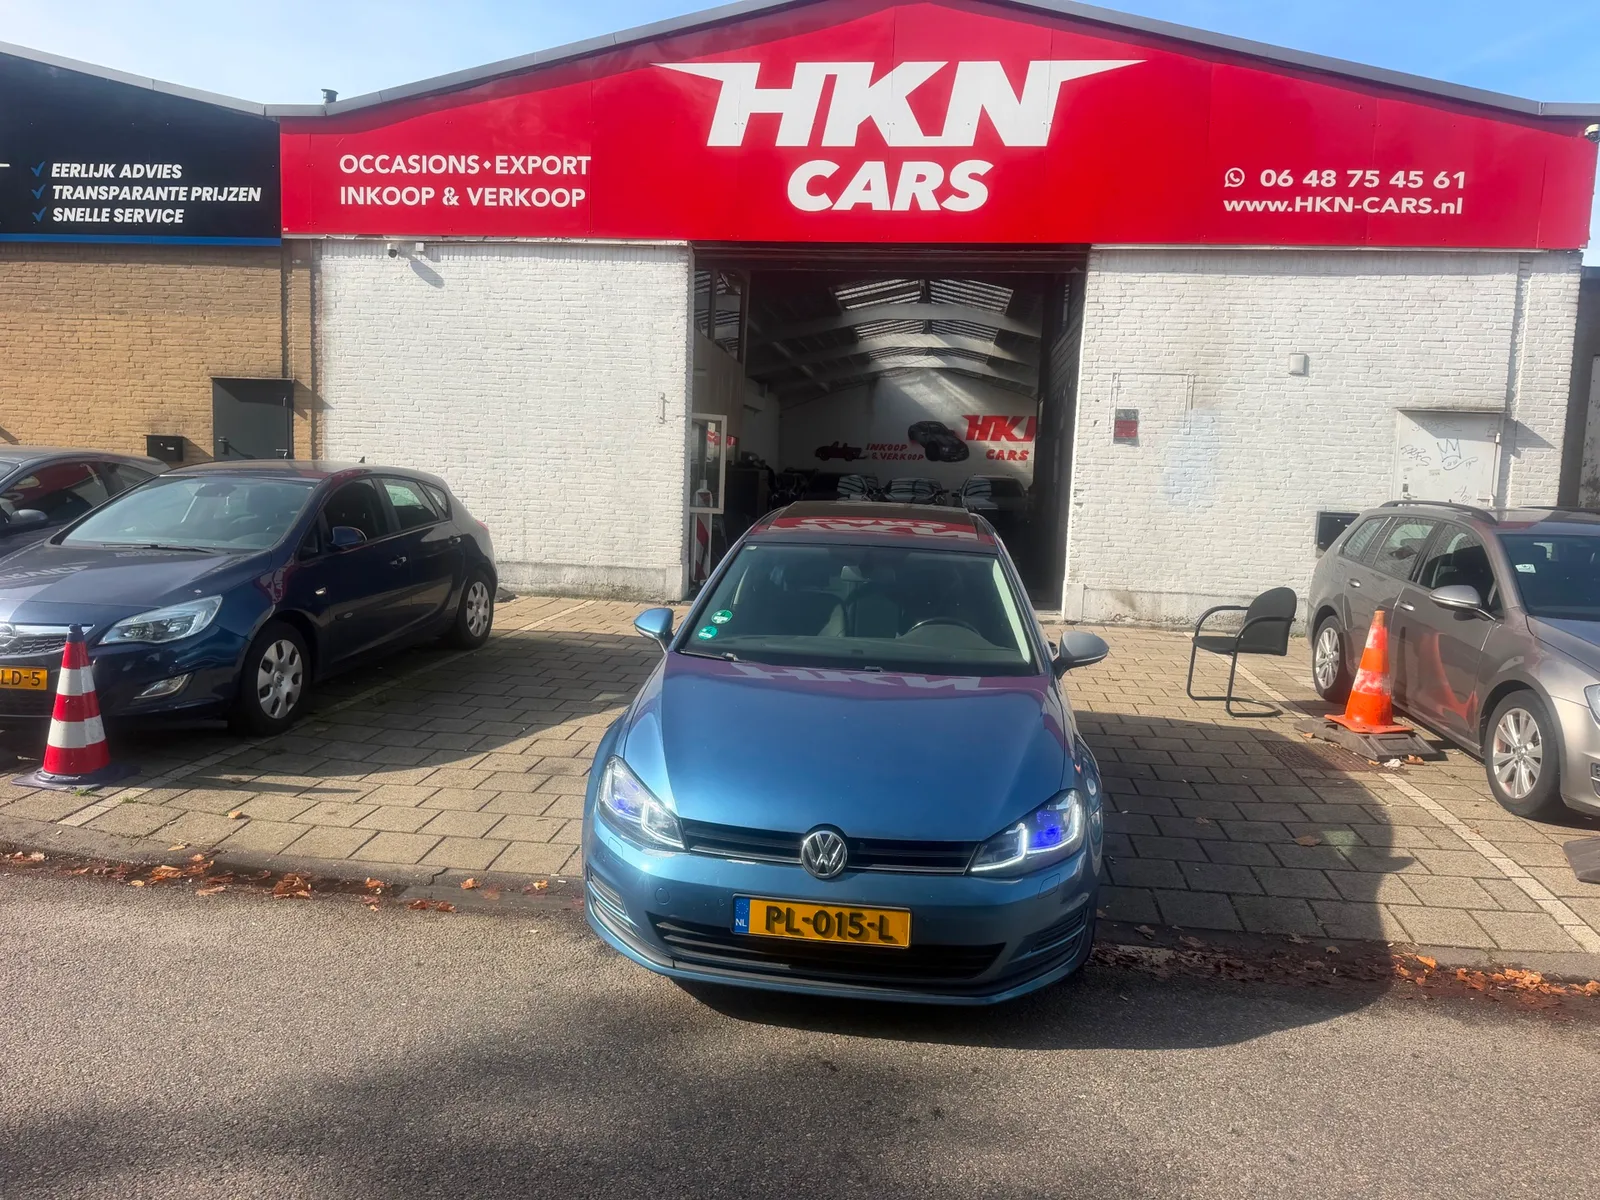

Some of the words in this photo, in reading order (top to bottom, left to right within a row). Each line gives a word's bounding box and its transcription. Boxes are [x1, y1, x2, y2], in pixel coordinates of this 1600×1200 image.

[651, 59, 1148, 147] HKN
[51, 163, 116, 178] EERLIJK
[119, 164, 183, 179] ADVIES
[339, 154, 480, 175] OCCASIONS
[495, 155, 592, 176] EXPORT
[787, 159, 994, 212] CARS
[1260, 169, 1294, 188] 06
[1302, 170, 1337, 188] 48
[1346, 170, 1380, 188] 75
[1389, 170, 1424, 189] 45
[1433, 171, 1466, 189] 61
[52, 185, 188, 201] TRANSPARANTE
[190, 186, 262, 202] PRIJZEN
[340, 186, 436, 206] INKOOP
[442, 186, 460, 206] &
[466, 187, 586, 208] VERKOOP
[1223, 196, 1463, 215] www.HKN-CARS.nl
[52, 207, 111, 223] SNELLE
[113, 208, 185, 224] SERVICE
[866, 443, 909, 451] INKOOP
[985, 449, 1029, 461] CARS
[880, 452, 924, 461] VERKOOP
[0, 669, 41, 687] LD-5
[735, 918, 747, 927] NL
[765, 905, 893, 941] PL-015-L
